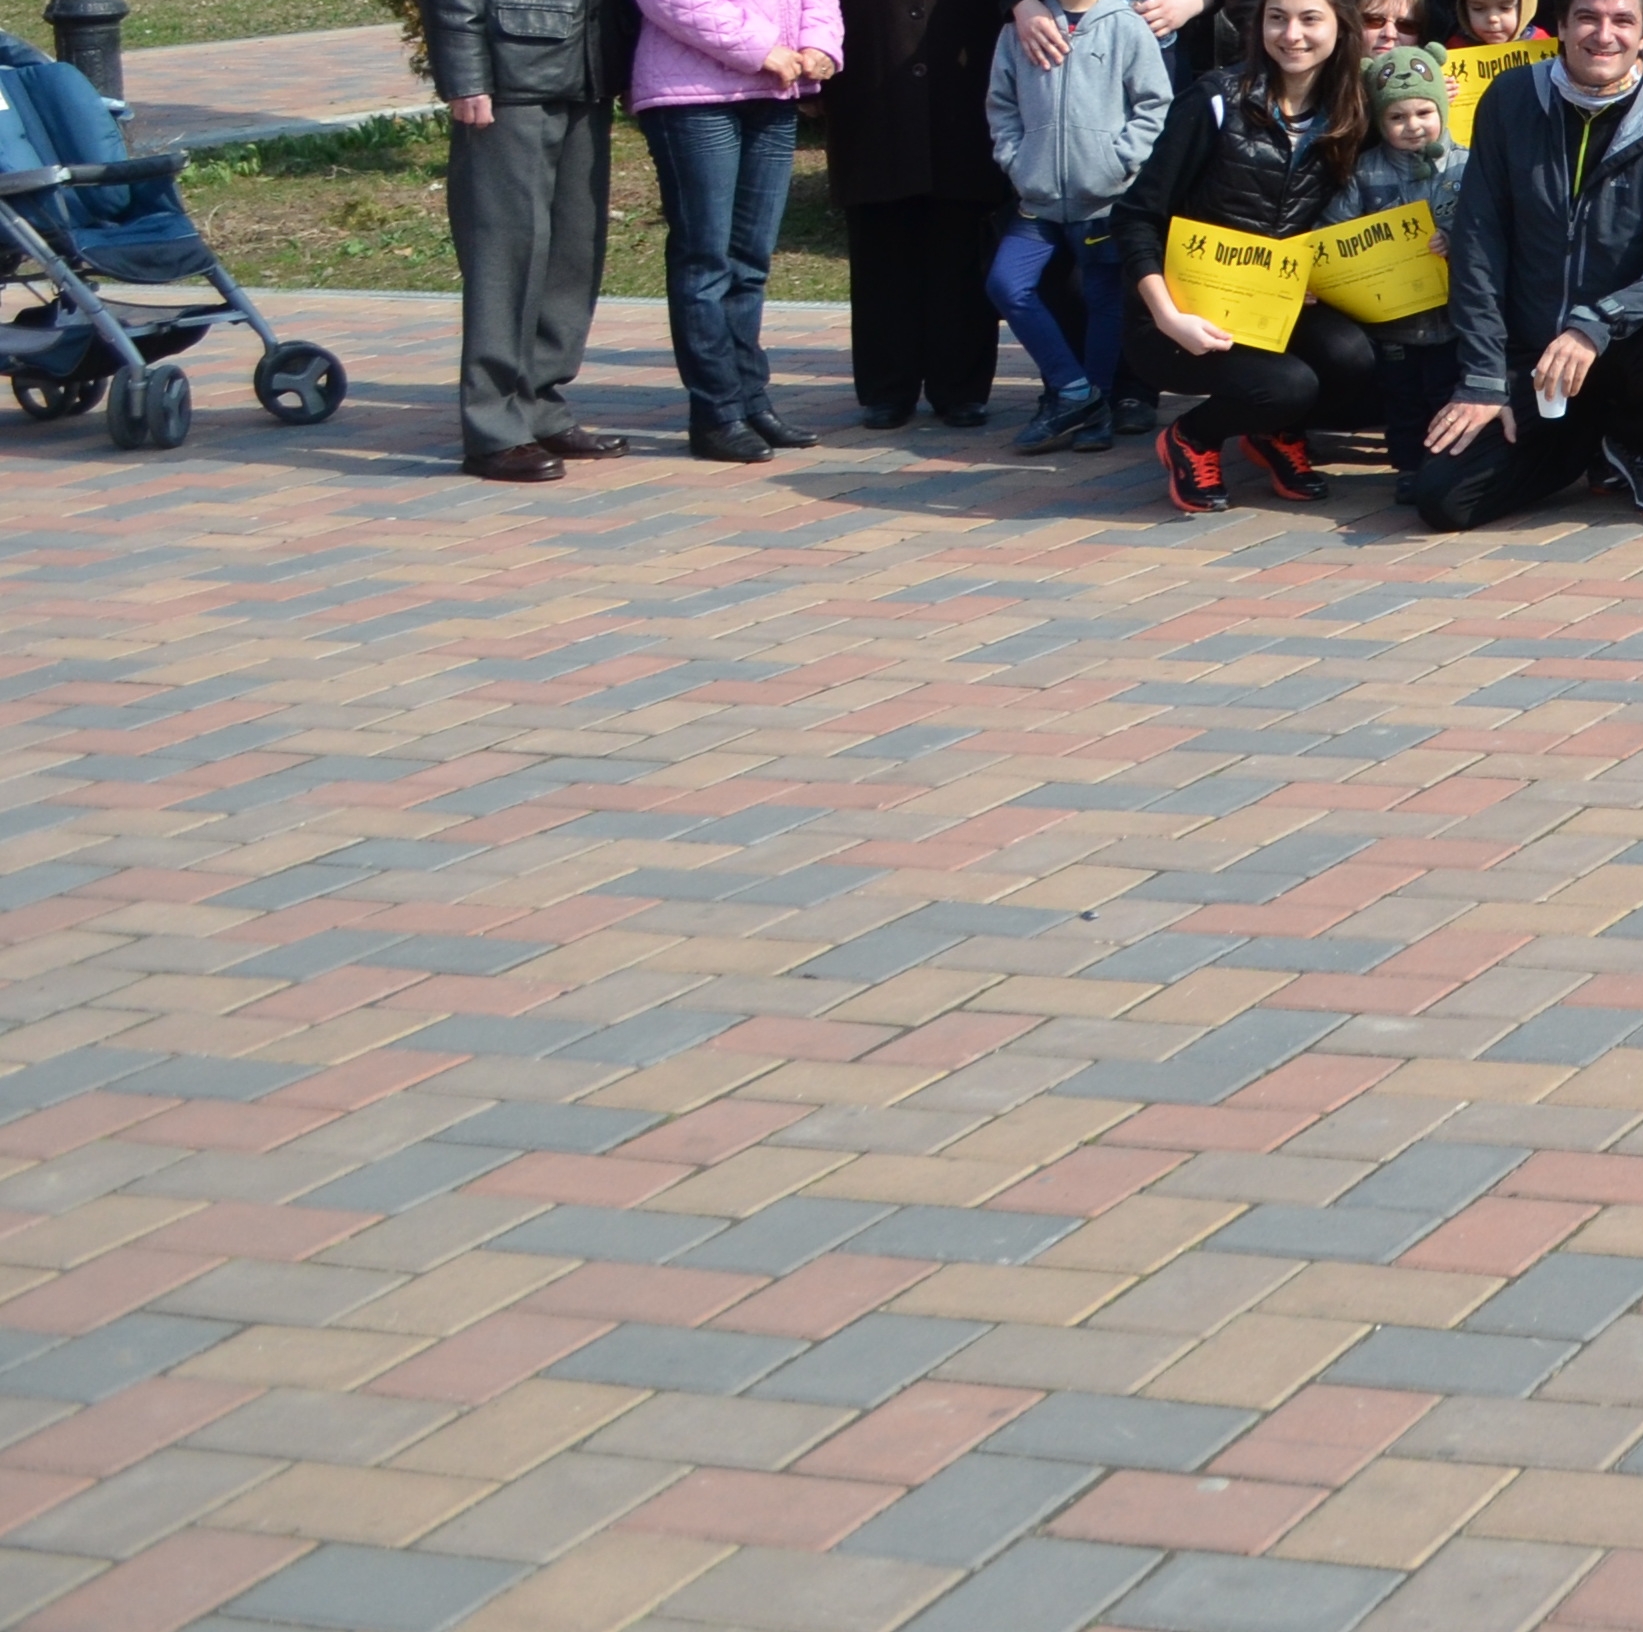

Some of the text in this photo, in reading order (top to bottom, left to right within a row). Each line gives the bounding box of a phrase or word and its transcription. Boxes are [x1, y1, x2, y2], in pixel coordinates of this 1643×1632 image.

[1477, 50, 1531, 80] DIPLOMA
[1336, 222, 1395, 258] DIPLOMA
[1215, 241, 1273, 270] DIPLOMA
